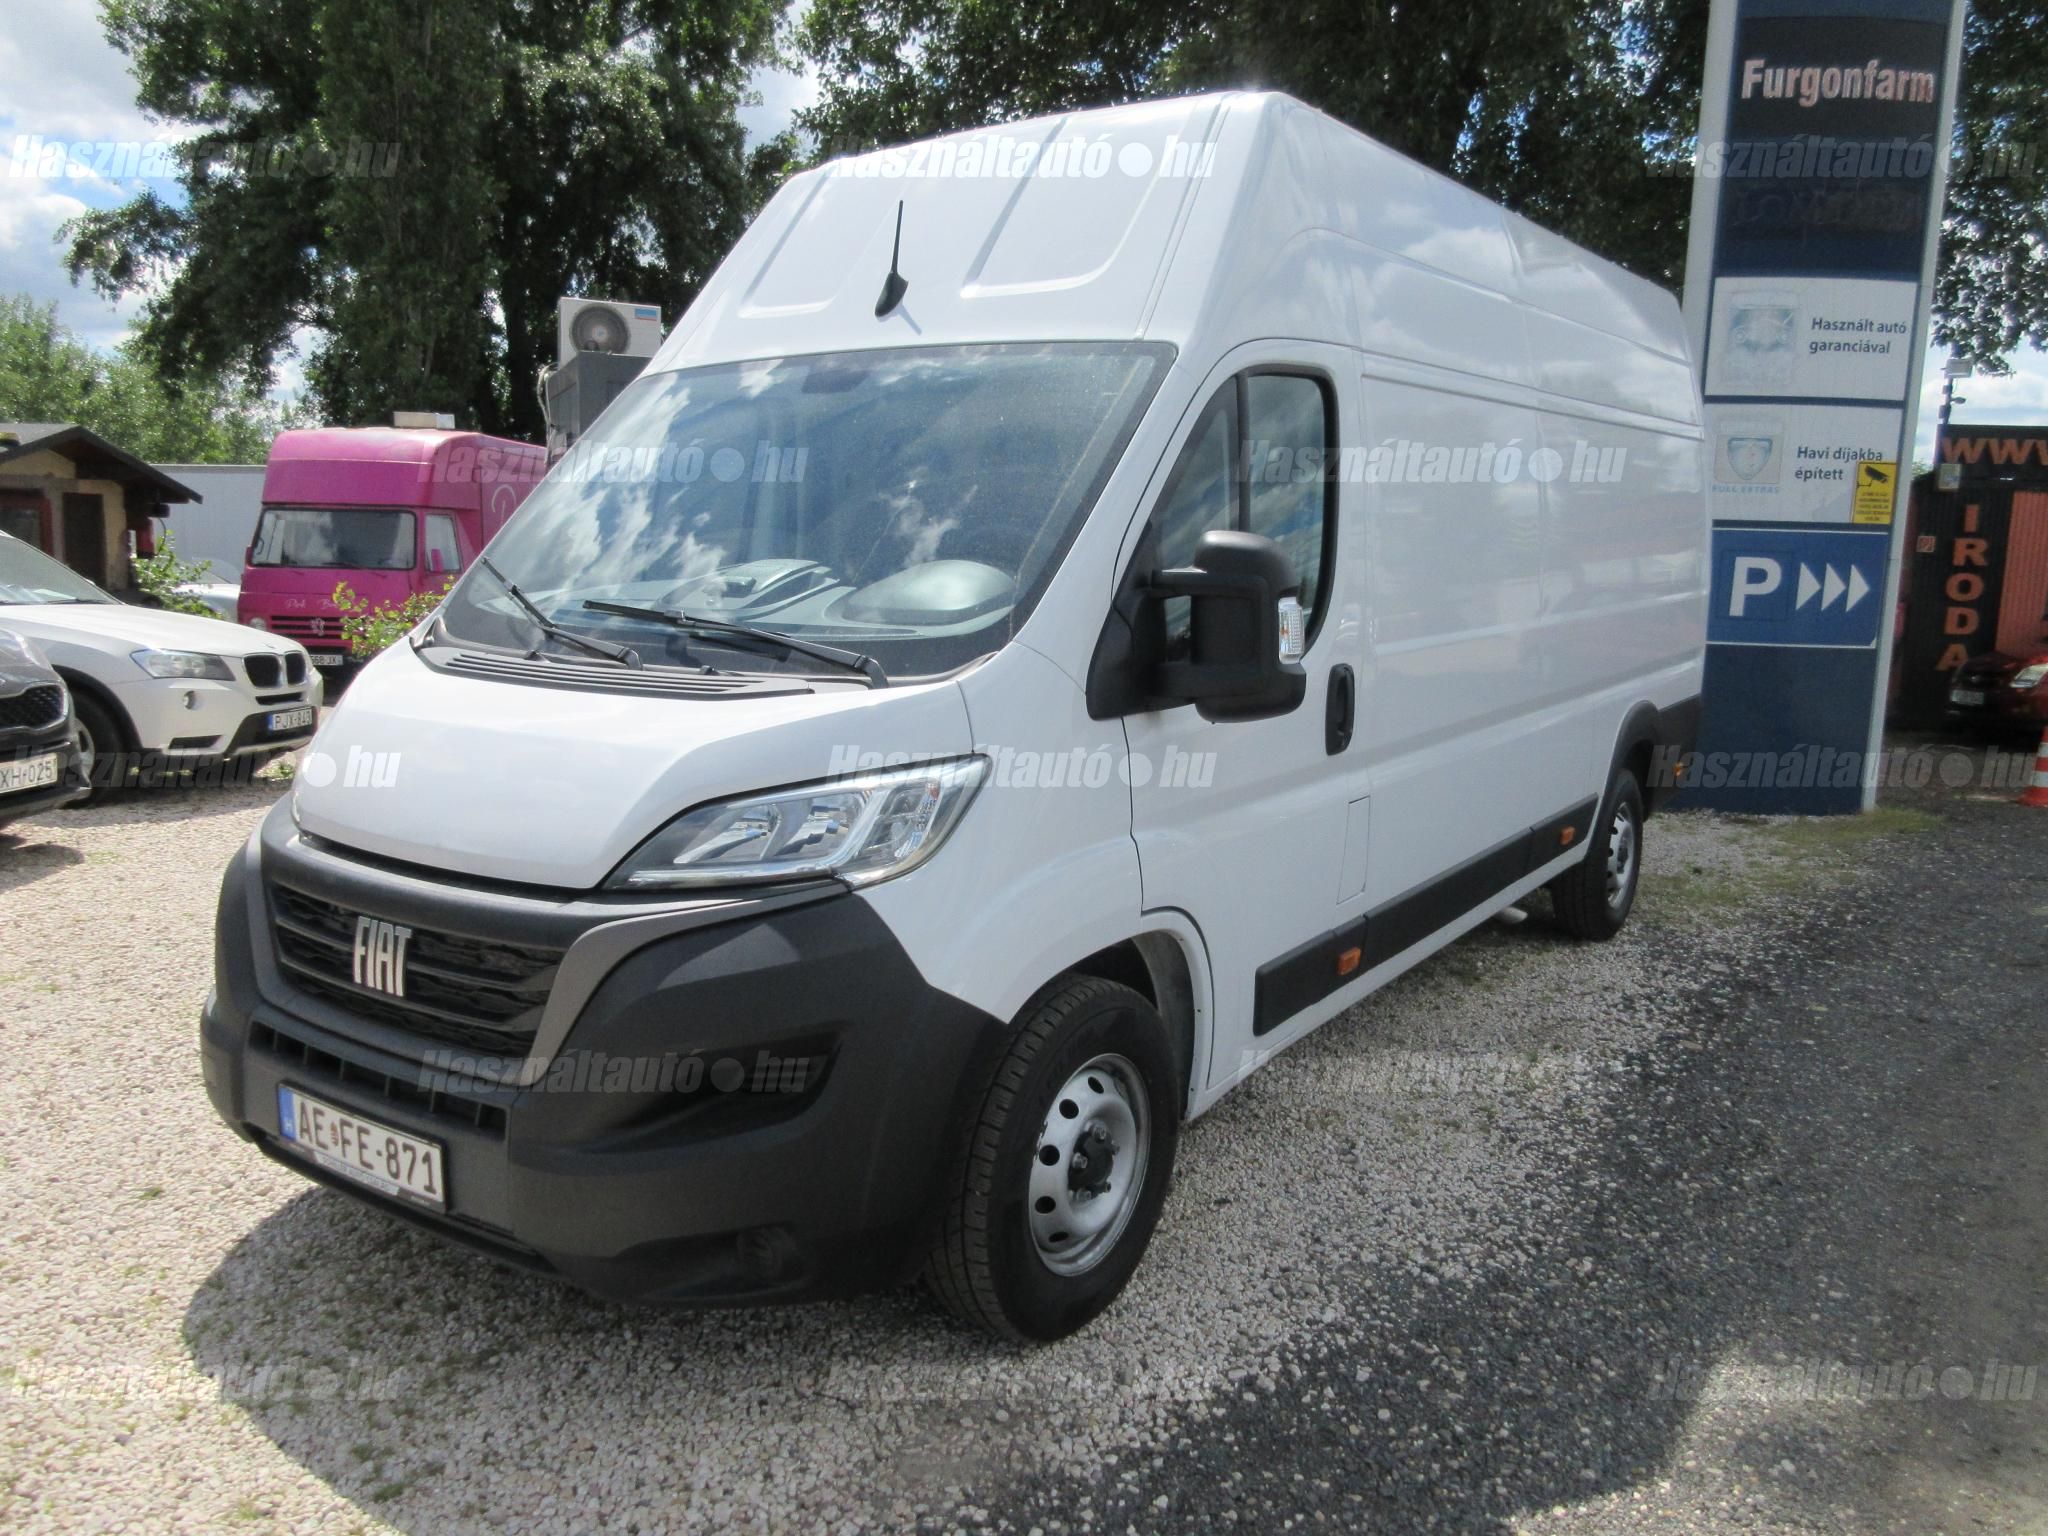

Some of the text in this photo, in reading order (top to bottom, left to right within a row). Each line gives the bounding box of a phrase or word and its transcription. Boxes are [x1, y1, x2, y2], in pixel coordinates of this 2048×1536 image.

[1741, 58, 1936, 108] Furgonfarm
[1811, 317, 1907, 334] Használt autó
[1809, 338, 1891, 354] garanciával
[1797, 446, 1883, 463] Havi díjakba
[1794, 467, 1844, 482] épített
[1729, 556, 1782, 617] P
[353, 915, 413, 998] FIAT
